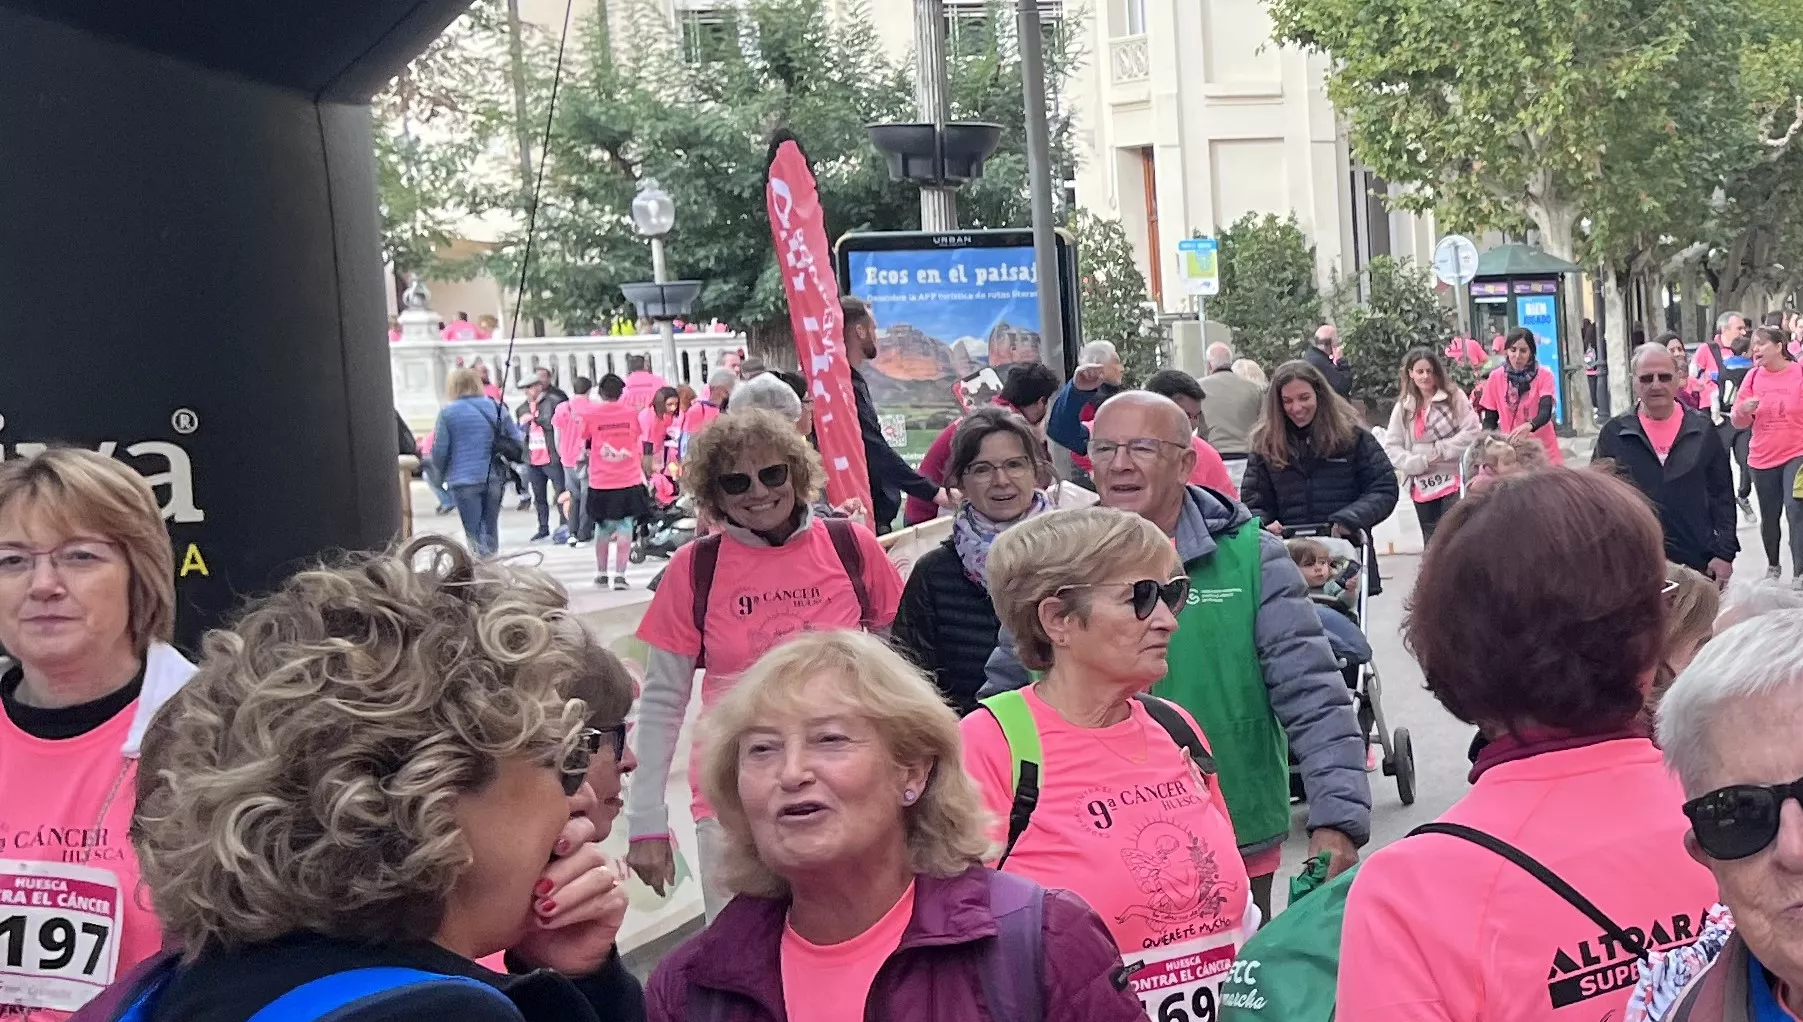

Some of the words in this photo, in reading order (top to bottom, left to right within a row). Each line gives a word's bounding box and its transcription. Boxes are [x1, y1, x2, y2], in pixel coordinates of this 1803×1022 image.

[932, 236, 972, 245] URBAN
[865, 266, 909, 286] Ecos
[917, 268, 941, 284] en
[949, 264, 968, 284] el
[1119, 780, 1188, 806] CÁNCER
[15, 876, 69, 893] HUESCA
[32, 889, 54, 905] EL
[57, 891, 111, 915] CÁNCER
[1165, 955, 1201, 972] HUESCA
[1130, 971, 1179, 992] ONTRA
[1179, 969, 1195, 982] EL
